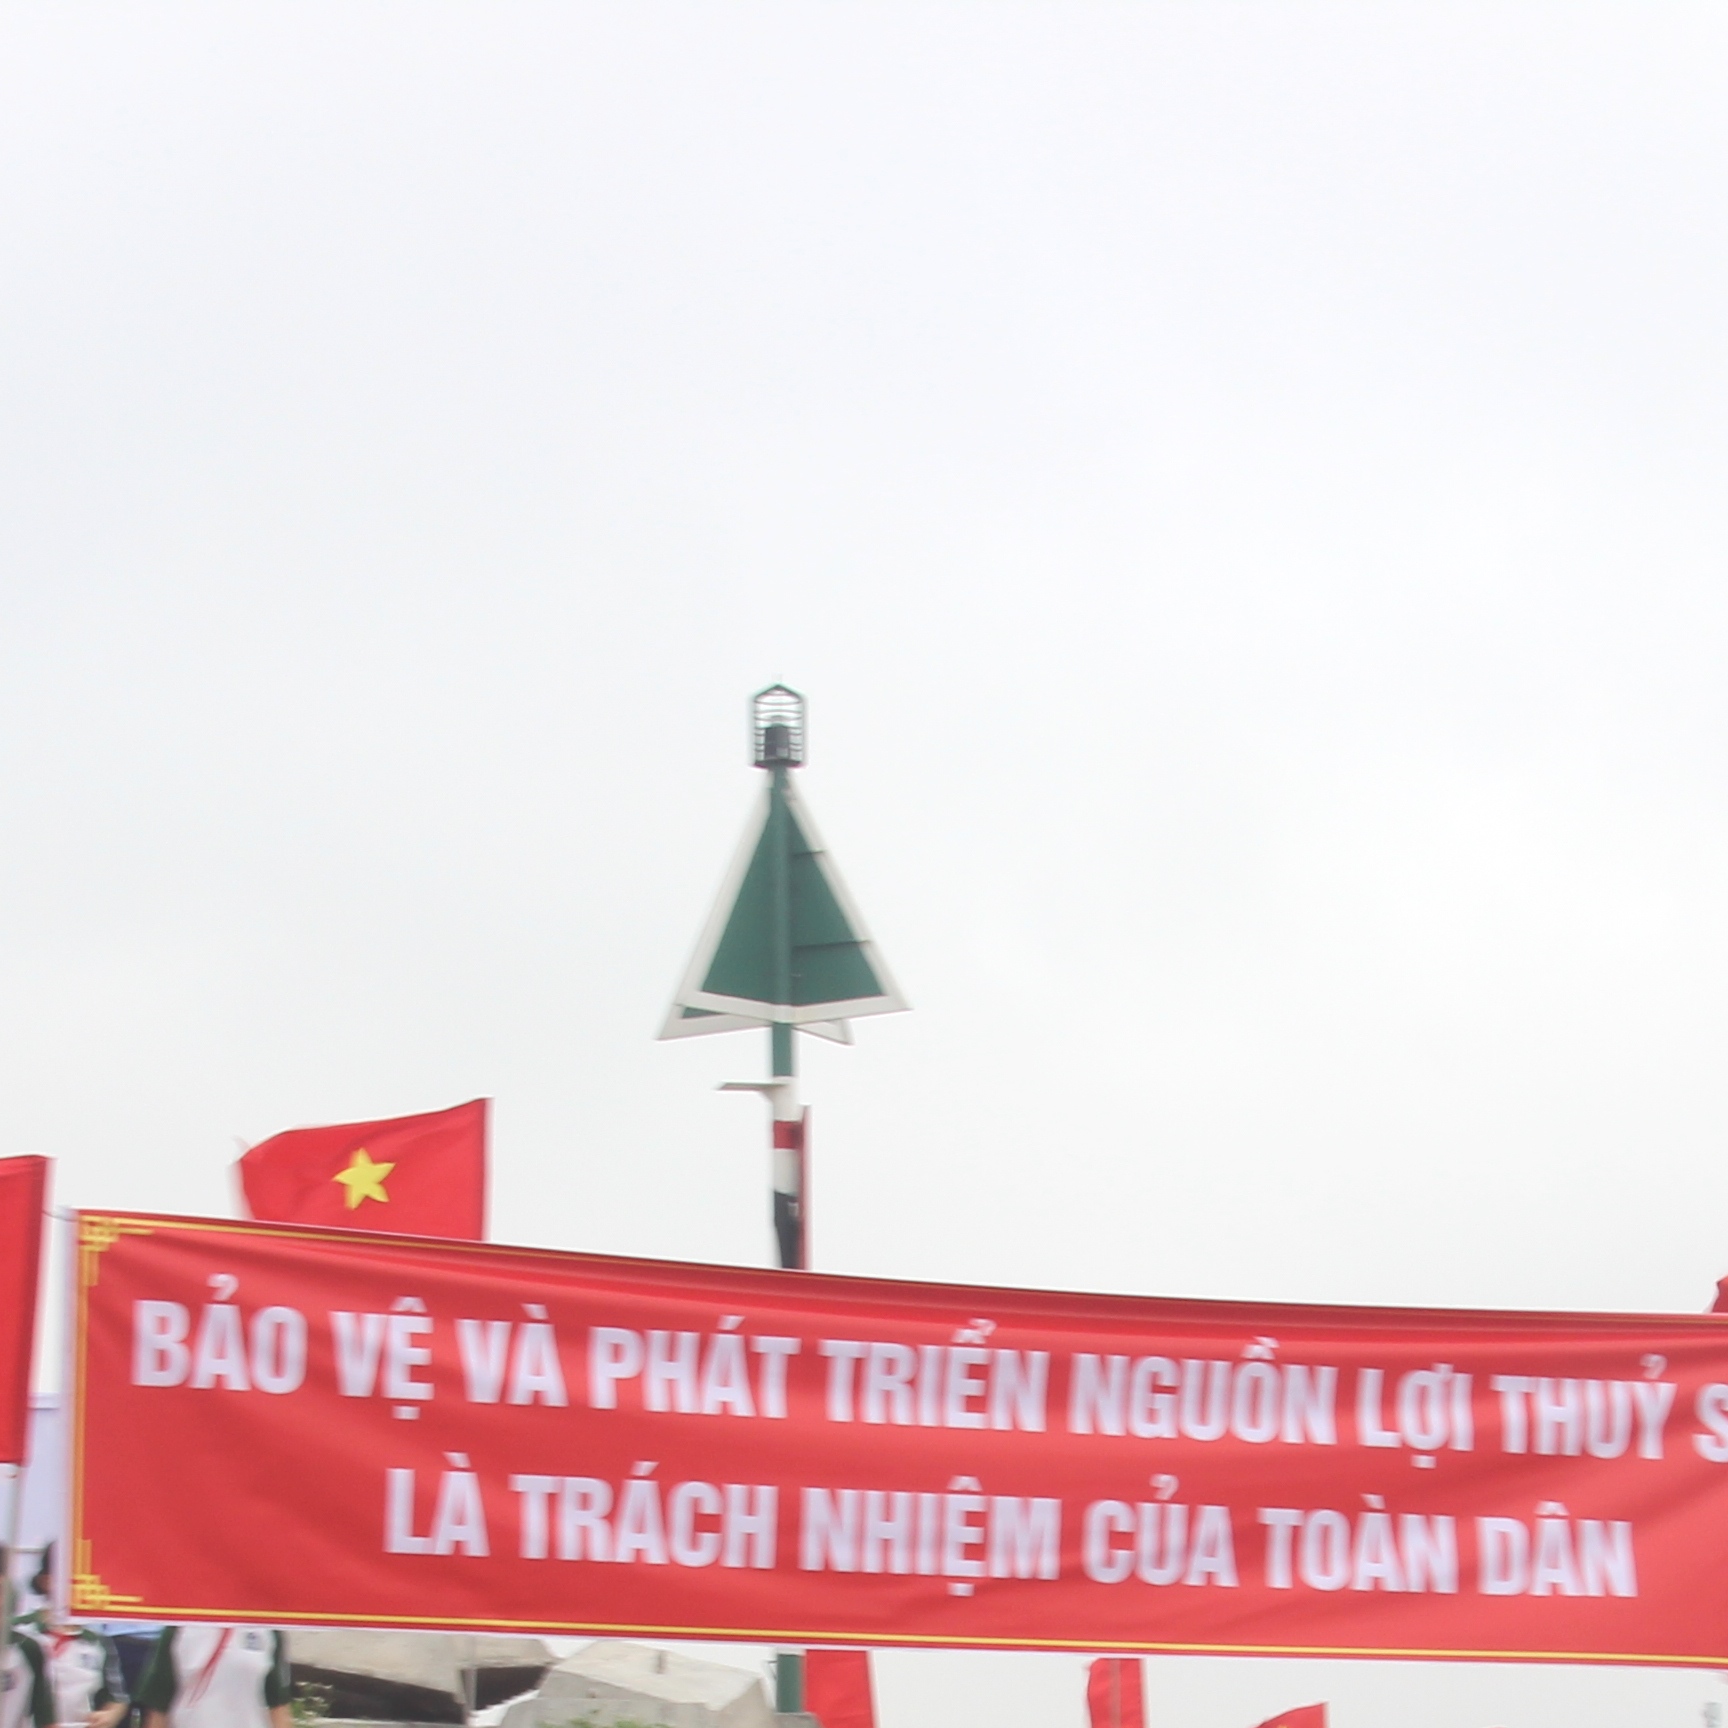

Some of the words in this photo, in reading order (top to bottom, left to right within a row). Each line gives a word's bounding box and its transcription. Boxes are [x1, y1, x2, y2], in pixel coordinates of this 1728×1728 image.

[131, 1273, 308, 1395] BẢO
[328, 1296, 435, 1420] VỆ
[454, 1303, 568, 1407] VÀ
[586, 1314, 802, 1419] PHÁT
[819, 1318, 1050, 1433] TRIỂN
[1066, 1336, 1340, 1446] NGUỒN
[1354, 1362, 1475, 1469] LỢI
[1490, 1354, 1679, 1461] THUỶ
[384, 1451, 489, 1557] LÀ
[510, 1460, 780, 1569] TRÁCH
[799, 1475, 1062, 1597] NHIỆM
[1081, 1473, 1240, 1588] CỦA
[1258, 1493, 1460, 1595] TOÀN
[1474, 1500, 1639, 1598] DÂN
